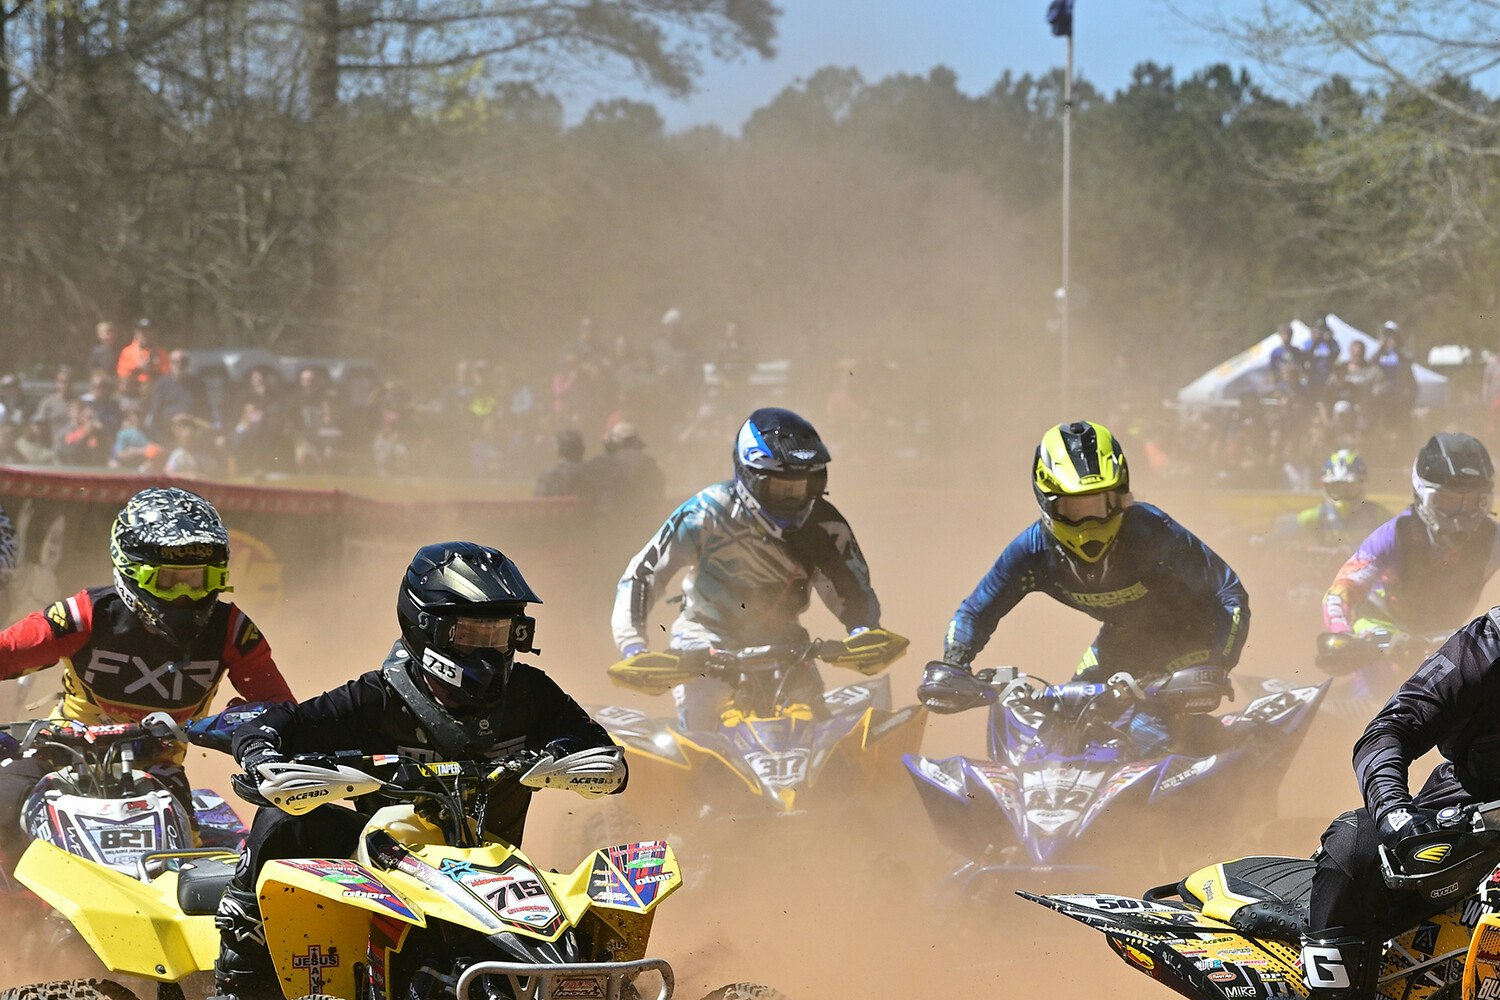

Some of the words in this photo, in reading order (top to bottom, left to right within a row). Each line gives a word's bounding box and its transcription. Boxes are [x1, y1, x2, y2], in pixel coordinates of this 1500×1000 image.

[418, 655, 457, 680] 715
[84, 649, 220, 701] FXR
[286, 789, 329, 803] ACERBIS
[100, 830, 153, 849] 821
[342, 889, 392, 900] obor
[485, 879, 546, 912] 715
[1430, 882, 1459, 899] CYCRA
[1096, 898, 1154, 909] 501
[1202, 936, 1234, 945] ACERBIS
[295, 955, 338, 967] JESUS
[1225, 986, 1257, 997] Mika
